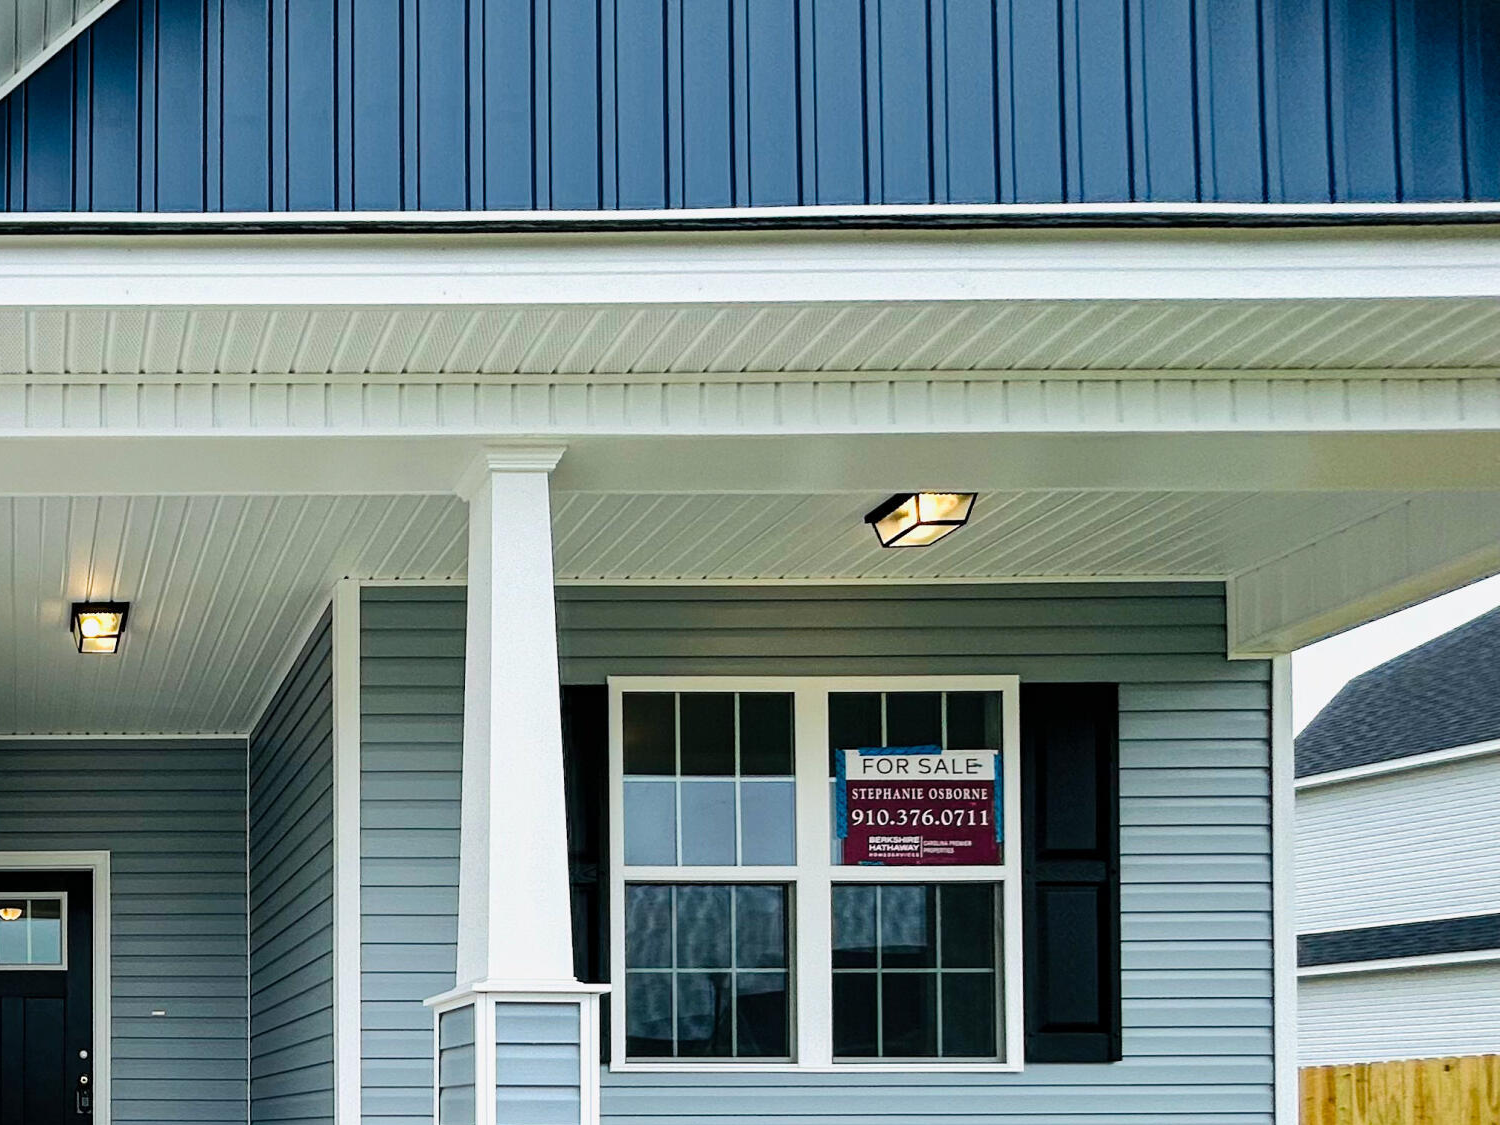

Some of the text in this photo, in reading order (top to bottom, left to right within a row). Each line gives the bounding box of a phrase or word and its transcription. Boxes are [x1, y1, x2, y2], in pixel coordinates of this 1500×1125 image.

[862, 758, 979, 775] FOR SALE
[851, 788, 988, 800] STEPHANIE OSBORNE
[851, 809, 988, 826] 910.376.0711
[868, 844, 920, 852] HATHAWAY
